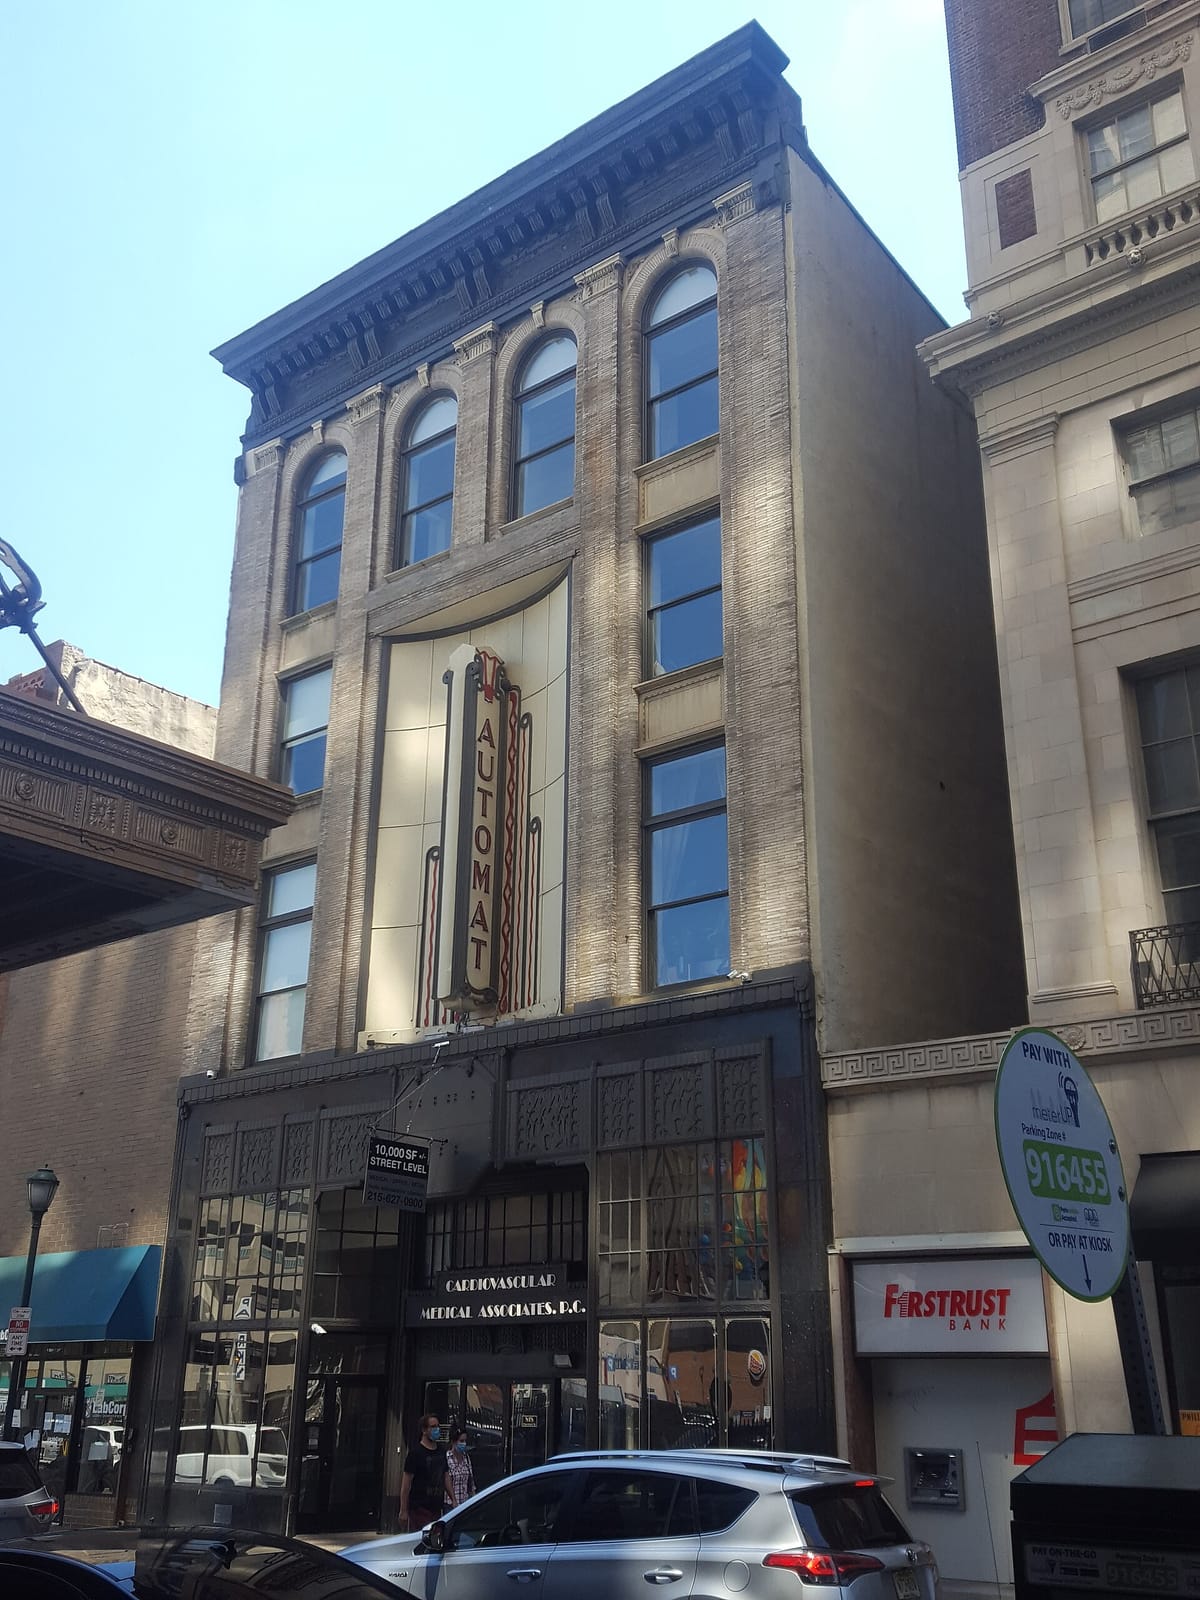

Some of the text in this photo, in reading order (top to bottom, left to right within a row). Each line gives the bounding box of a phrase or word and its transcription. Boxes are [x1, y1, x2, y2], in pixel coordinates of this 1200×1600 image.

[470, 717, 496, 970] AUTOMAT
[1021, 1041, 1071, 1069] PAY WITH
[1021, 1122, 1046, 1140] Parking
[1046, 1128, 1061, 1140] Zone
[375, 1144, 405, 1159] 10,000
[405, 1149, 418, 1161] SF
[369, 1156, 427, 1174] STREET LEVEL
[1025, 1148, 1109, 1197] 916455
[1048, 1232, 1113, 1252] OR PAY AT KIOSK
[445, 1273, 557, 1293] CARDIOVASCULAR
[420, 1305, 473, 1320] MEDICAL
[559, 1299, 586, 1315] P.C.
[15, 1320, 24, 1328] NO
[949, 1318, 1007, 1331] BANK
